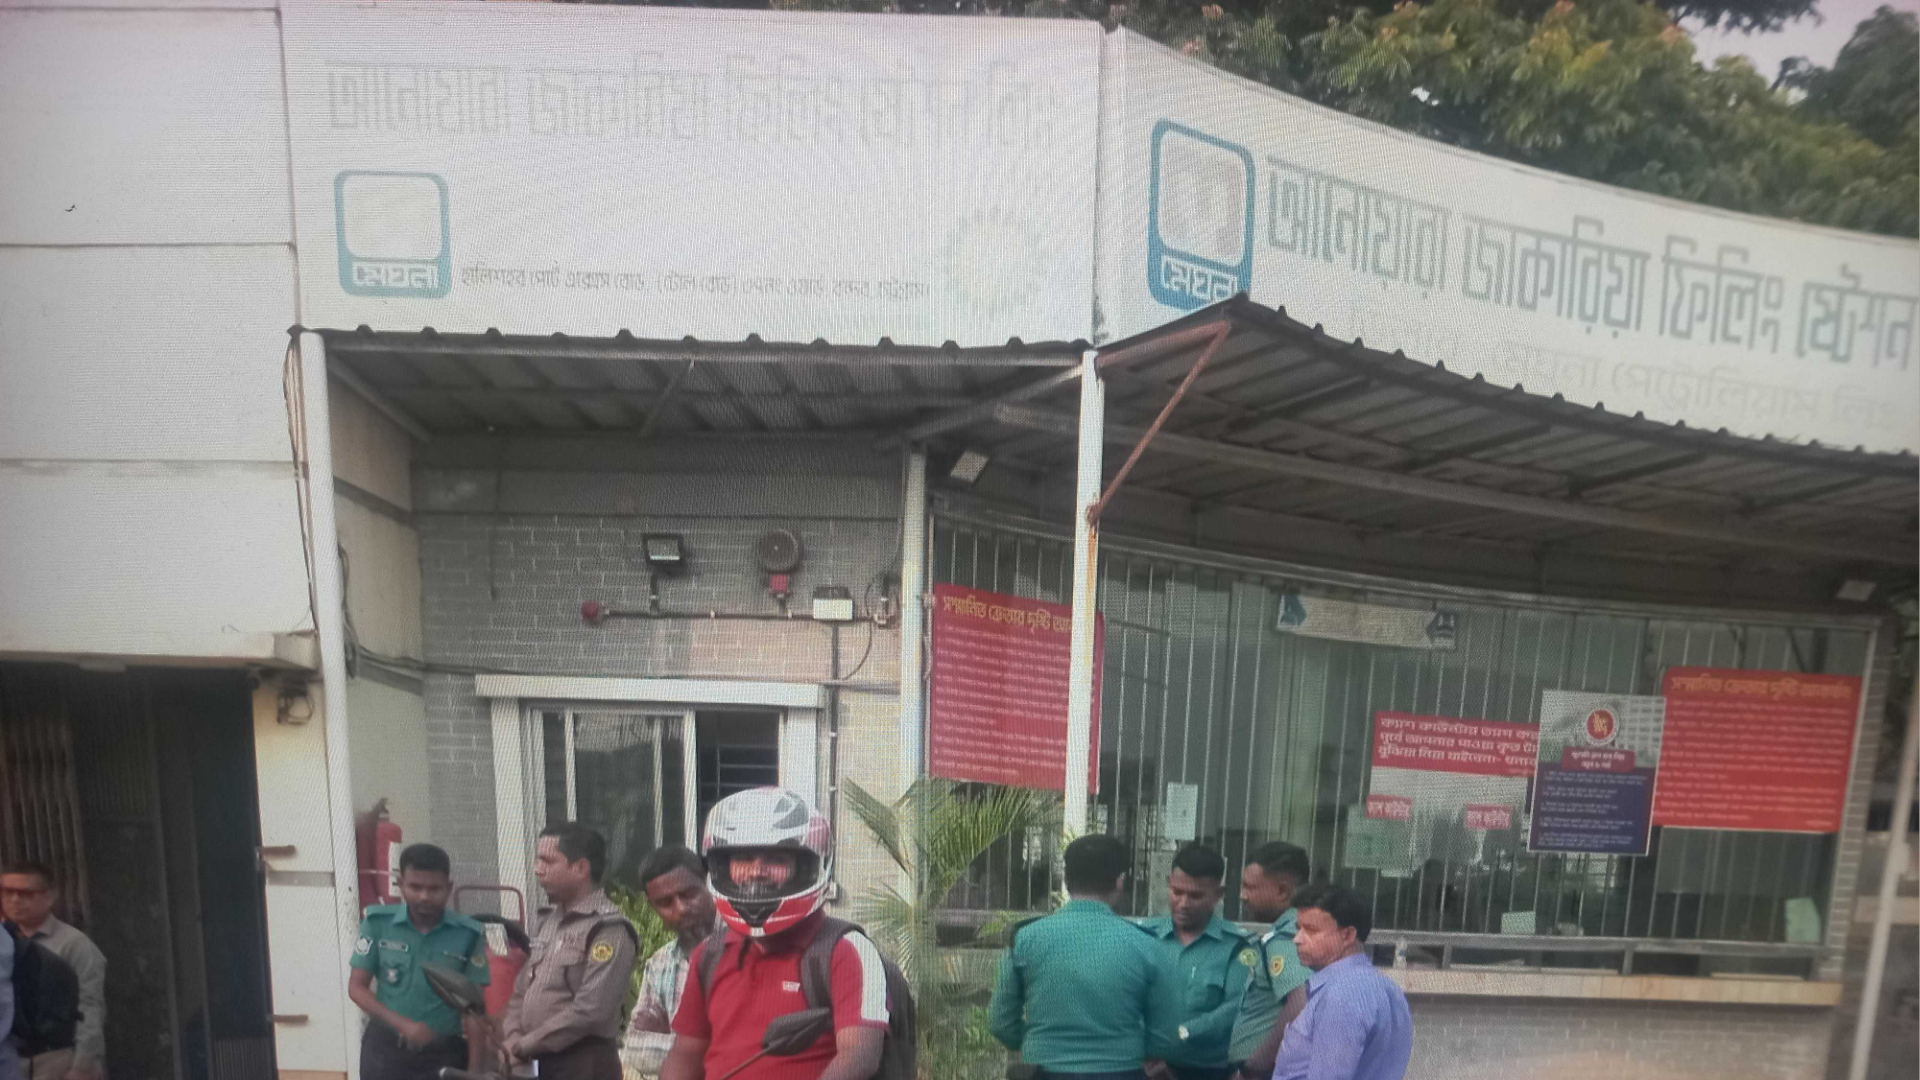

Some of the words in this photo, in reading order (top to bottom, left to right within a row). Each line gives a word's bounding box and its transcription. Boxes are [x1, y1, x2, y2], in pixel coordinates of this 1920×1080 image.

[1161, 254, 1237, 301] মেঘনা
[1267, 154, 1452, 299] আনোয়ারা
[1462, 215, 1652, 338] জাকারিয়া
[1660, 233, 1784, 354] ফিলিং
[1795, 263, 1920, 371] স্টেশন
[943, 594, 987, 618] সম্মানিত
[1026, 608, 1051, 635] দৃষ্টি
